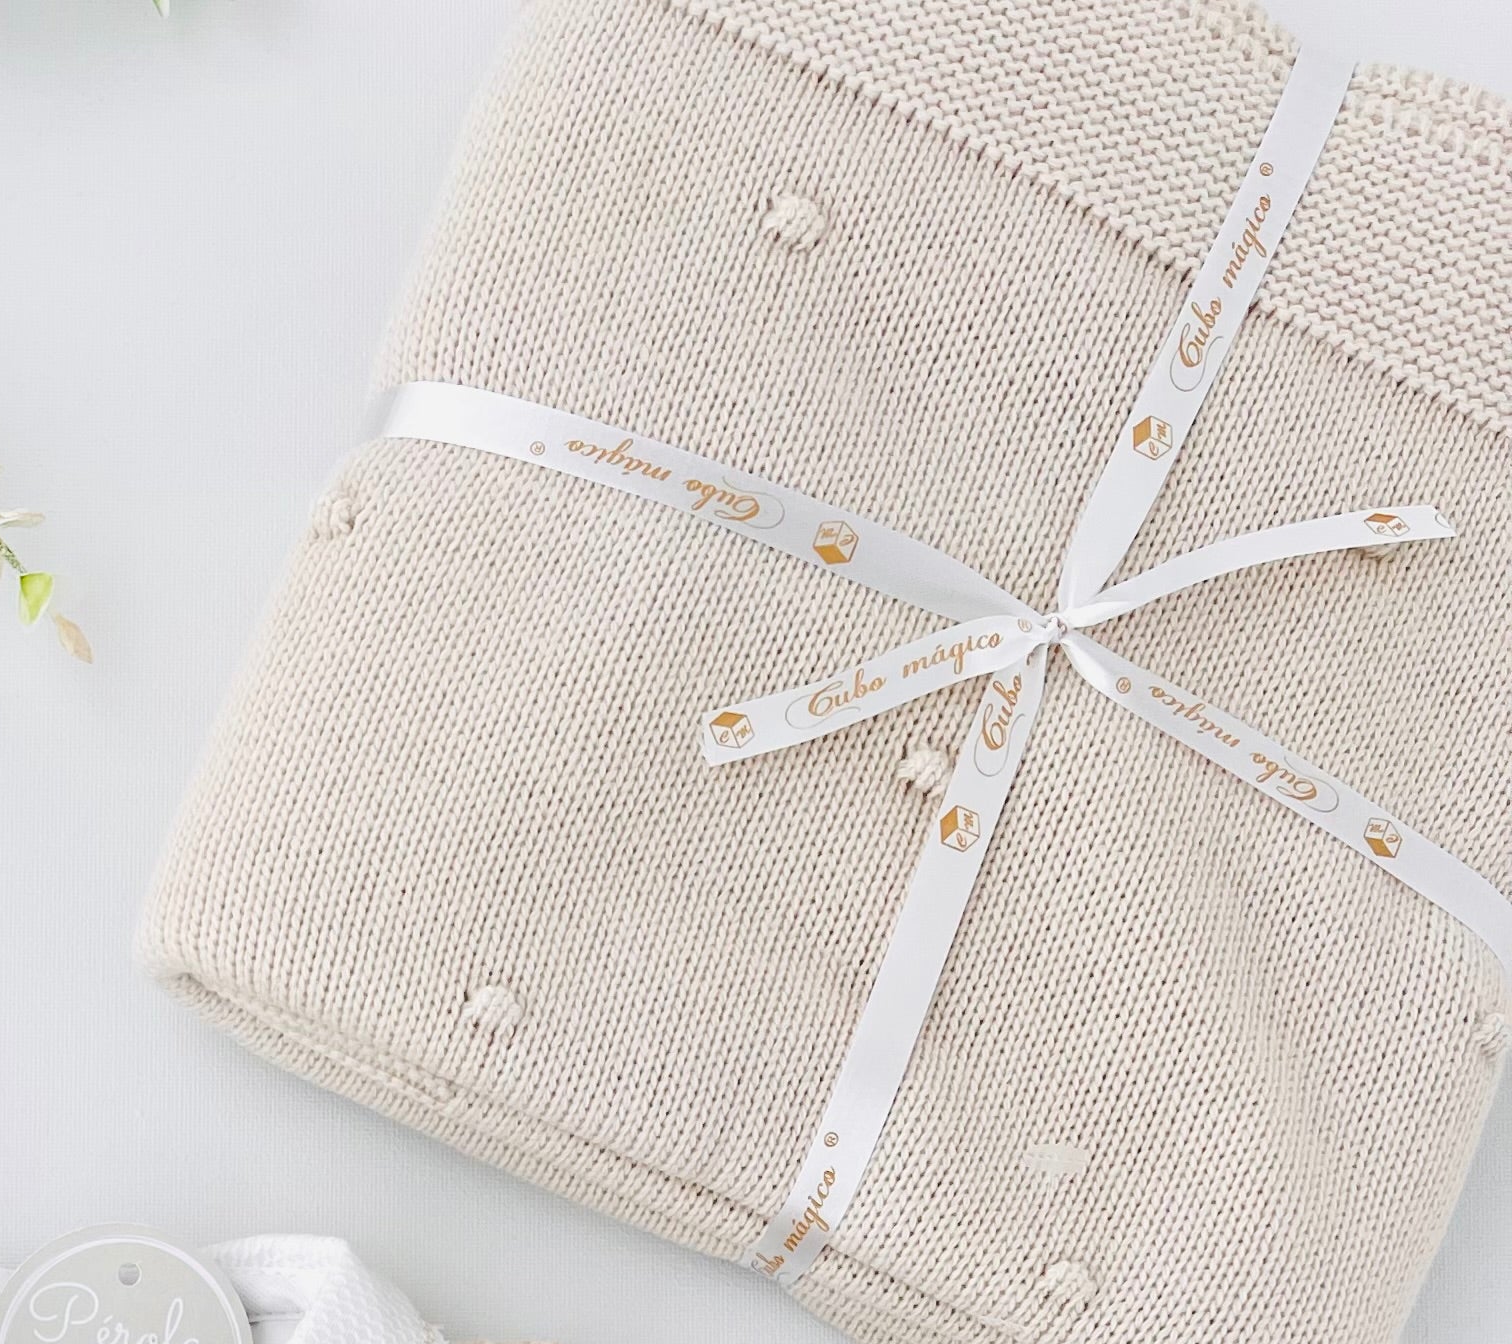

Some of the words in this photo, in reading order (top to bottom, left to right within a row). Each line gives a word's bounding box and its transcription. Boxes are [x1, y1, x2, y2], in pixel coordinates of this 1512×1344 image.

[1170, 295, 1224, 392] Cubo
[1223, 193, 1271, 289] mágico
[564, 438, 672, 482] mágico
[682, 475, 785, 529] Cubo
[785, 668, 887, 730] Cubo
[902, 631, 1004, 675] mágico
[1148, 685, 1241, 748] mágico
[974, 672, 1025, 777] Cubo
[1249, 752, 1339, 813] Cubo
[784, 1166, 836, 1252] mágico
